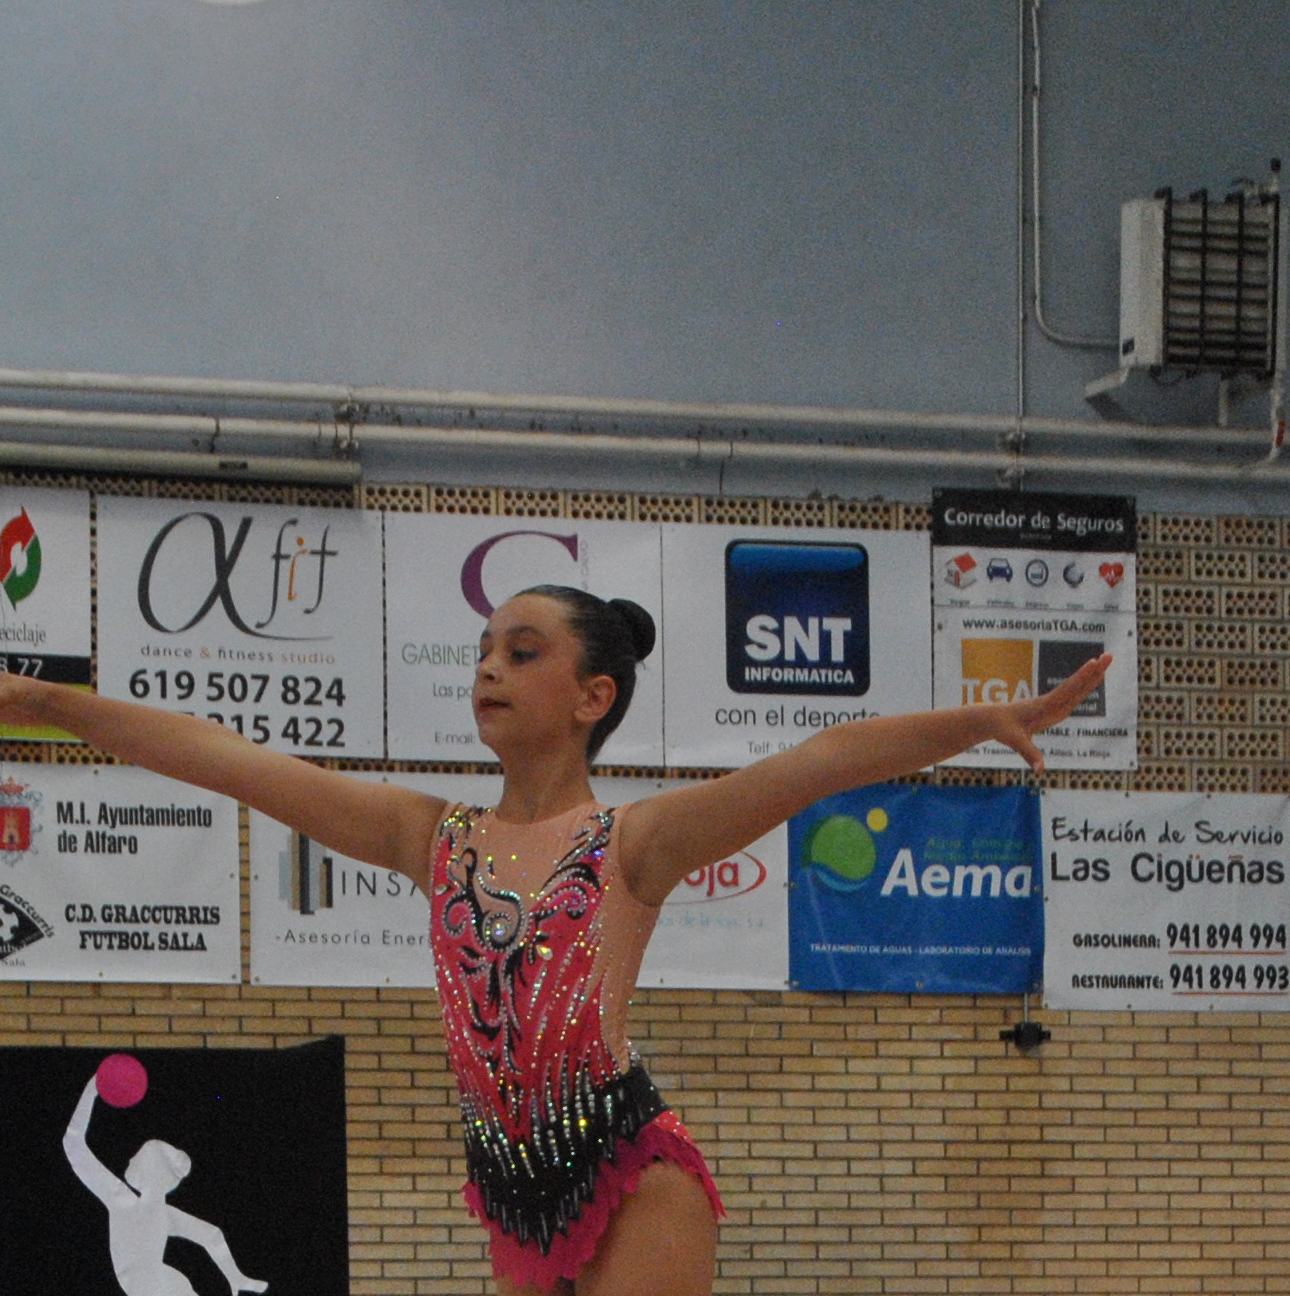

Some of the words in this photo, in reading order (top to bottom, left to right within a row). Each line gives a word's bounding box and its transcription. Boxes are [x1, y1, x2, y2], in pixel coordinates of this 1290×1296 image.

[944, 507, 1025, 529] Corredor
[1031, 511, 1050, 529] de
[1057, 513, 1124, 536] Seguros
[962, 618, 1106, 633] www.asesoriaTGA.com
[744, 614, 852, 663] SNT
[141, 644, 192, 660] dance
[218, 647, 273, 663] fitness
[281, 653, 336, 666] studio
[401, 642, 480, 667] GABINET
[17, 658, 43, 677] 77
[744, 666, 855, 685] INFORMATICA
[129, 669, 195, 700] 619
[206, 672, 270, 703] 507
[281, 675, 346, 707] 824
[433, 683, 454, 698] Las
[715, 708, 756, 725] con
[766, 705, 785, 726] el
[281, 717, 345, 748] 422
[56, 801, 91, 824] M.I.
[97, 803, 212, 829] Ayuntamiento
[57, 830, 78, 853] de
[84, 830, 138, 855] Alfaro
[1052, 817, 1146, 843] Estación
[1159, 821, 1185, 844] de
[1195, 820, 1284, 845] Servicio
[684, 862, 739, 897] oja
[880, 848, 1032, 898] Aema
[1051, 851, 1111, 882] Las
[1131, 852, 1285, 892] Cigüeñas
[65, 904, 97, 924] C.D.
[101, 905, 220, 925] GRACCURRIS
[79, 930, 155, 951] FUTBOL
[158, 932, 207, 952] SALA
[382, 930, 431, 946] Ener
[1073, 933, 1161, 948] GASOLINERA:
[1166, 922, 1200, 949] 941
[1207, 923, 1243, 949] 894
[1250, 923, 1287, 949] 994
[1072, 974, 1164, 989] RESTAURANTE:
[1170, 964, 1203, 989] 941
[1210, 964, 1246, 990] 894
[1253, 964, 1289, 990] 993
